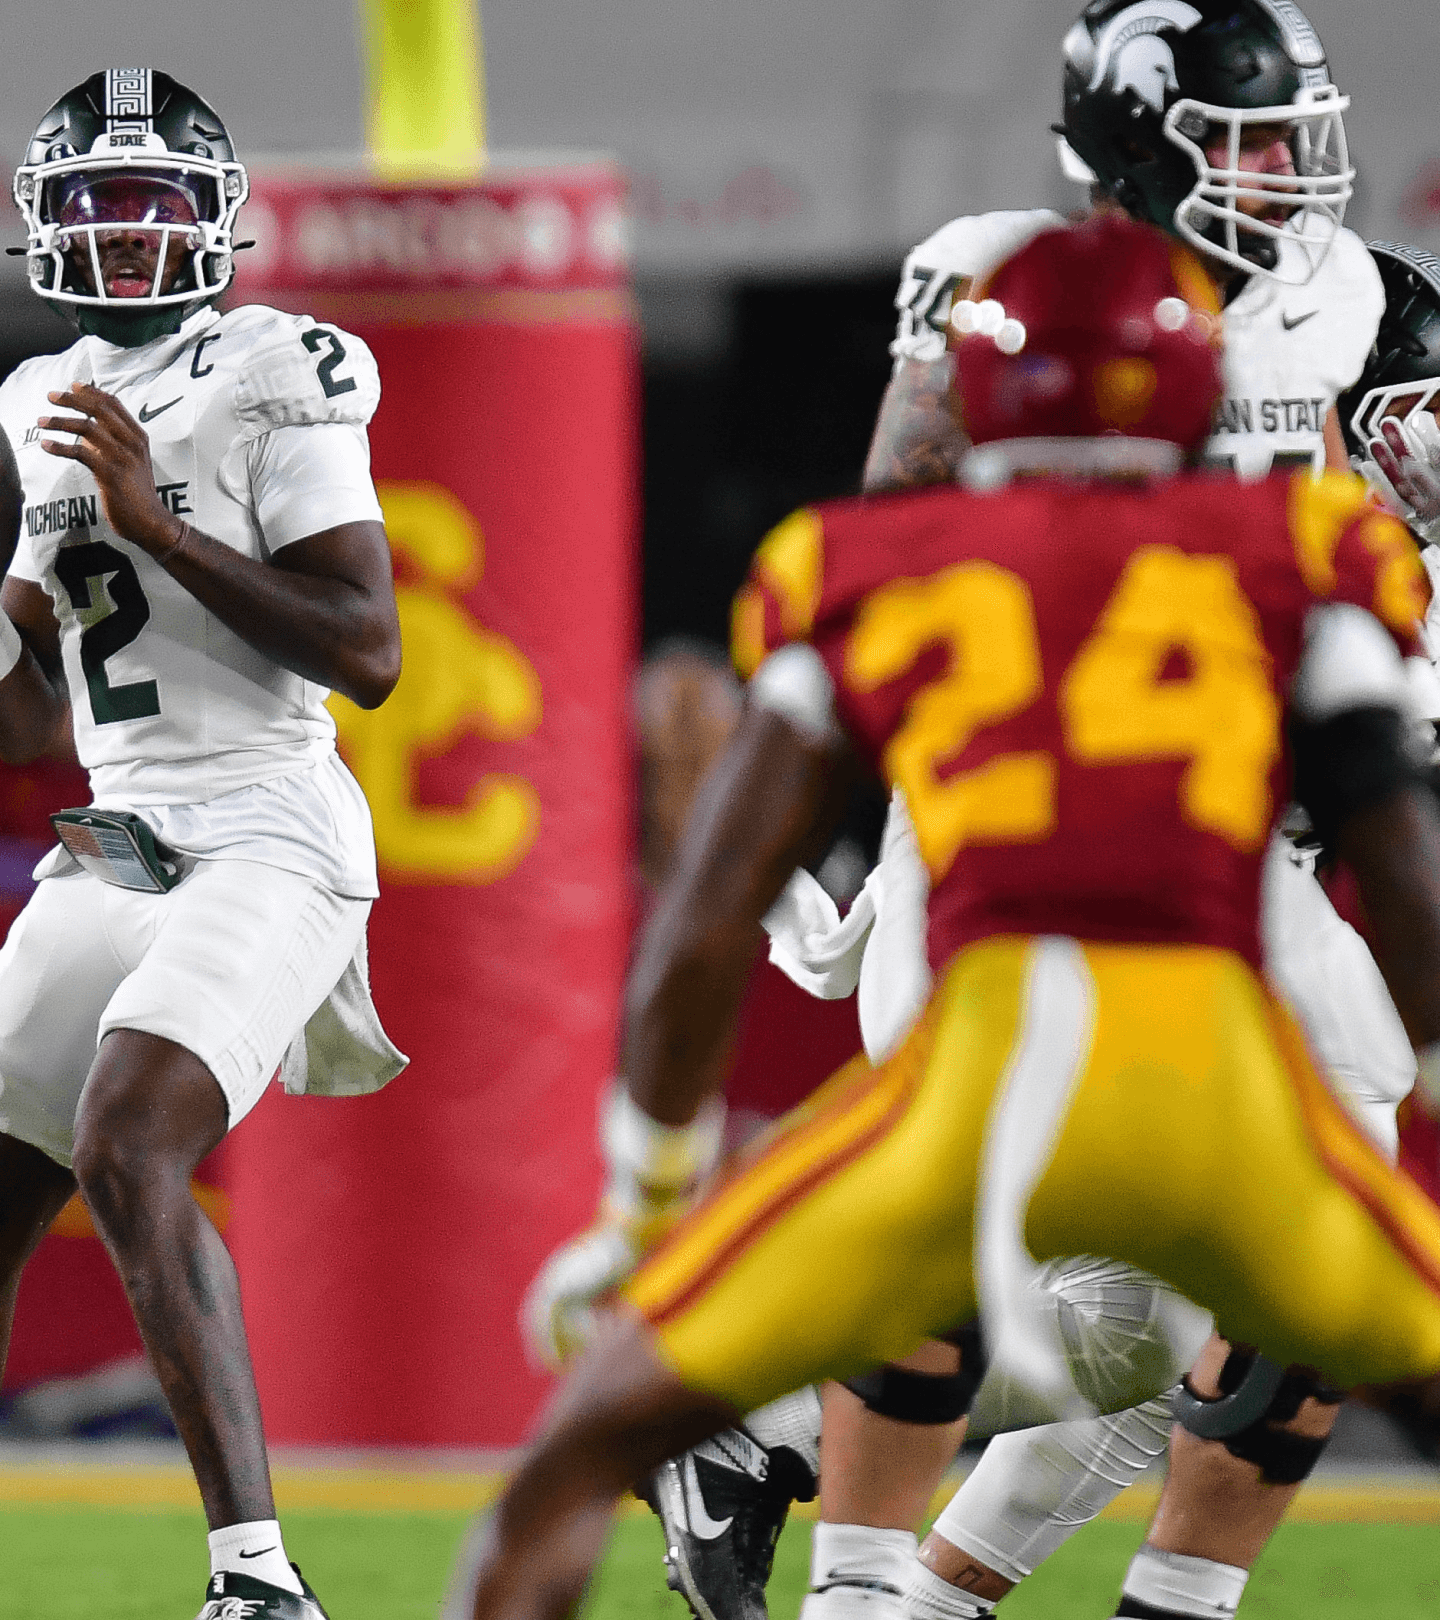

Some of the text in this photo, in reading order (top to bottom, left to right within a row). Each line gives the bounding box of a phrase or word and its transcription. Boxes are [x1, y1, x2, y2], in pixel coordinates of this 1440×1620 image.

[109, 134, 147, 147] STATE
[190, 333, 222, 379] C
[301, 328, 357, 399] 2
[1262, 397, 1327, 433] STAT
[54, 540, 162, 726] 2
[850, 546, 1280, 886] 24
